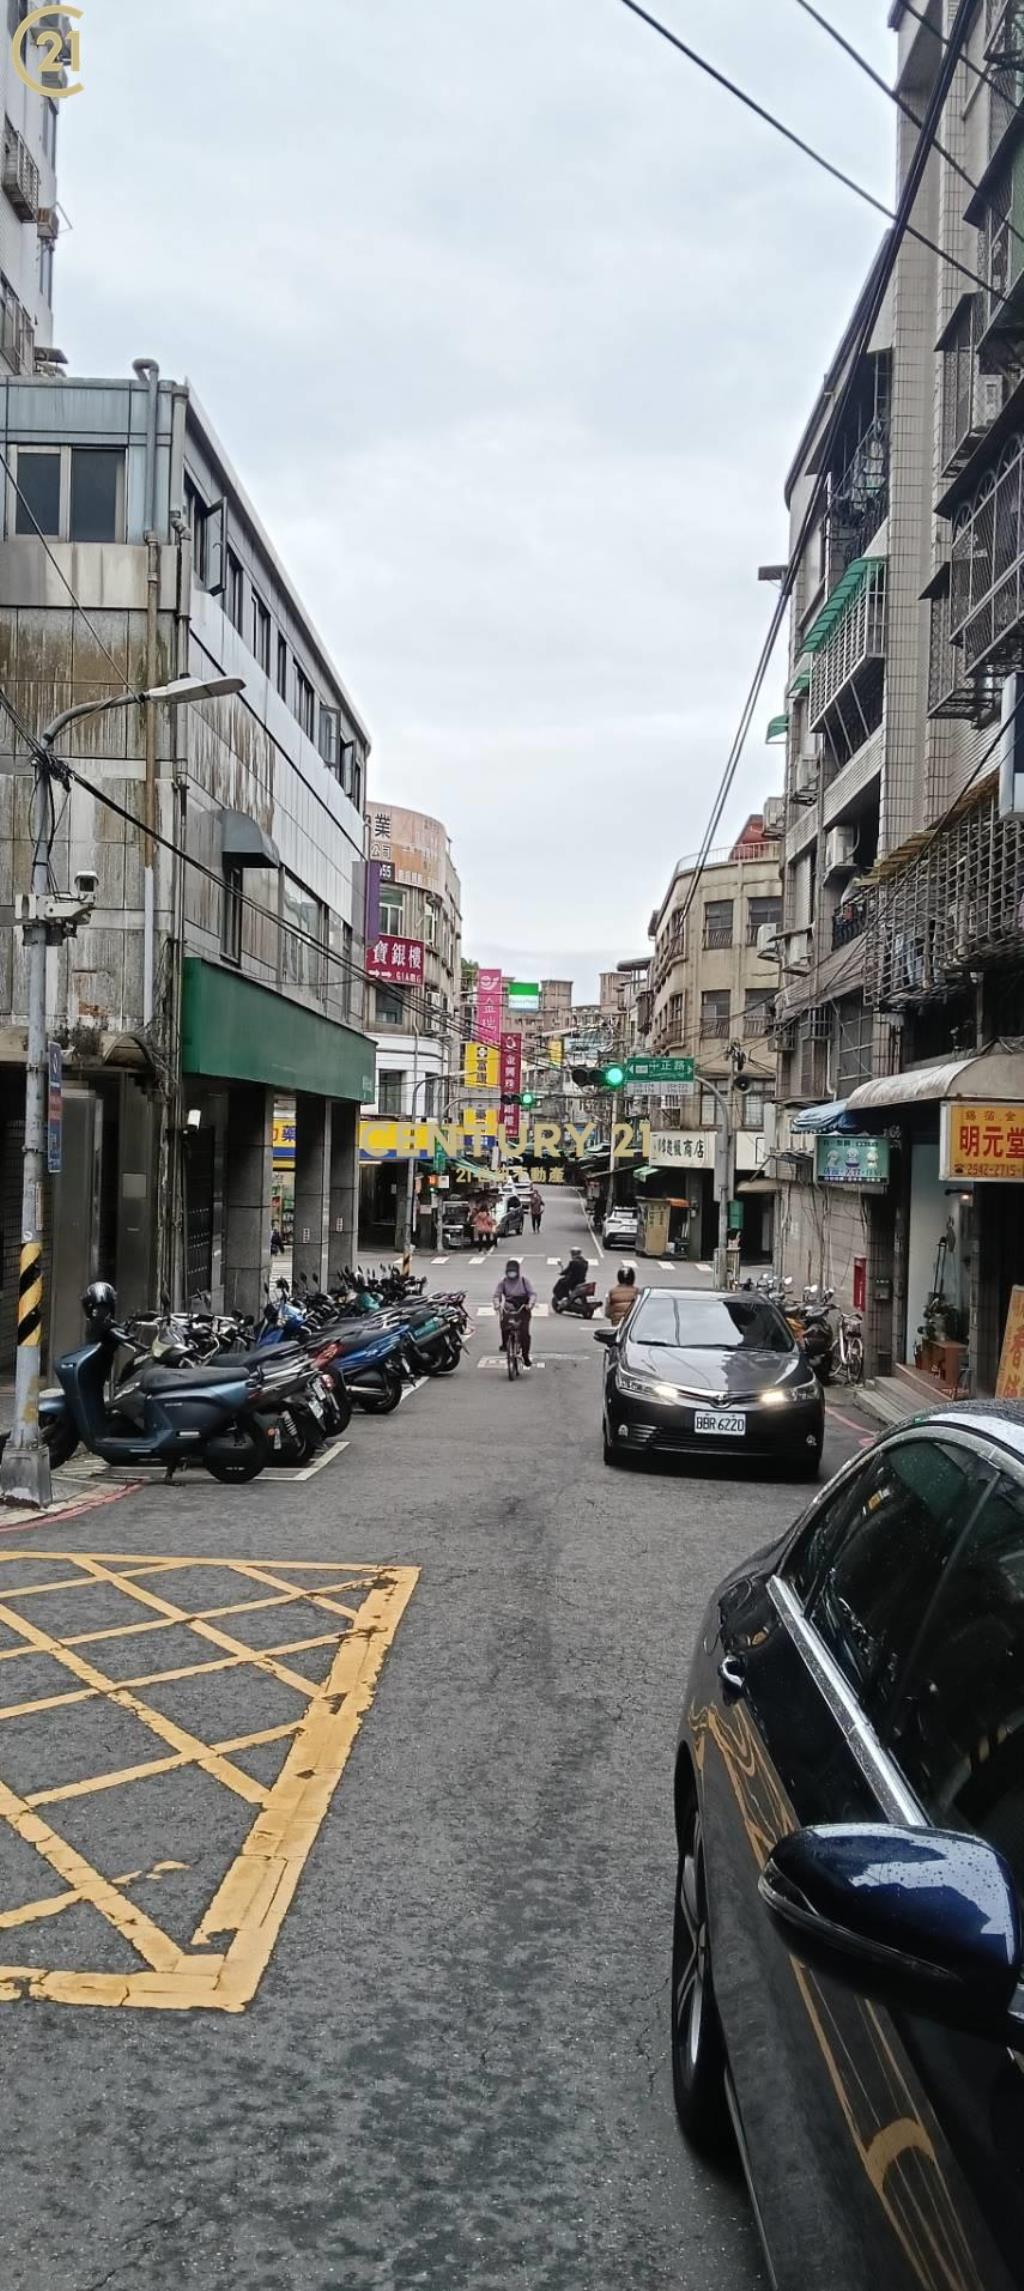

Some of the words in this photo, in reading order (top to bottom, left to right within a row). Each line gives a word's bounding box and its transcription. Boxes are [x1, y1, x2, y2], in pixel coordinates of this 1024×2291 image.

[374, 813, 391, 839] 業
[371, 844, 391, 860] 公司
[373, 940, 421, 970] 寶銀樓
[960, 1125, 1024, 1159] 明元堂
